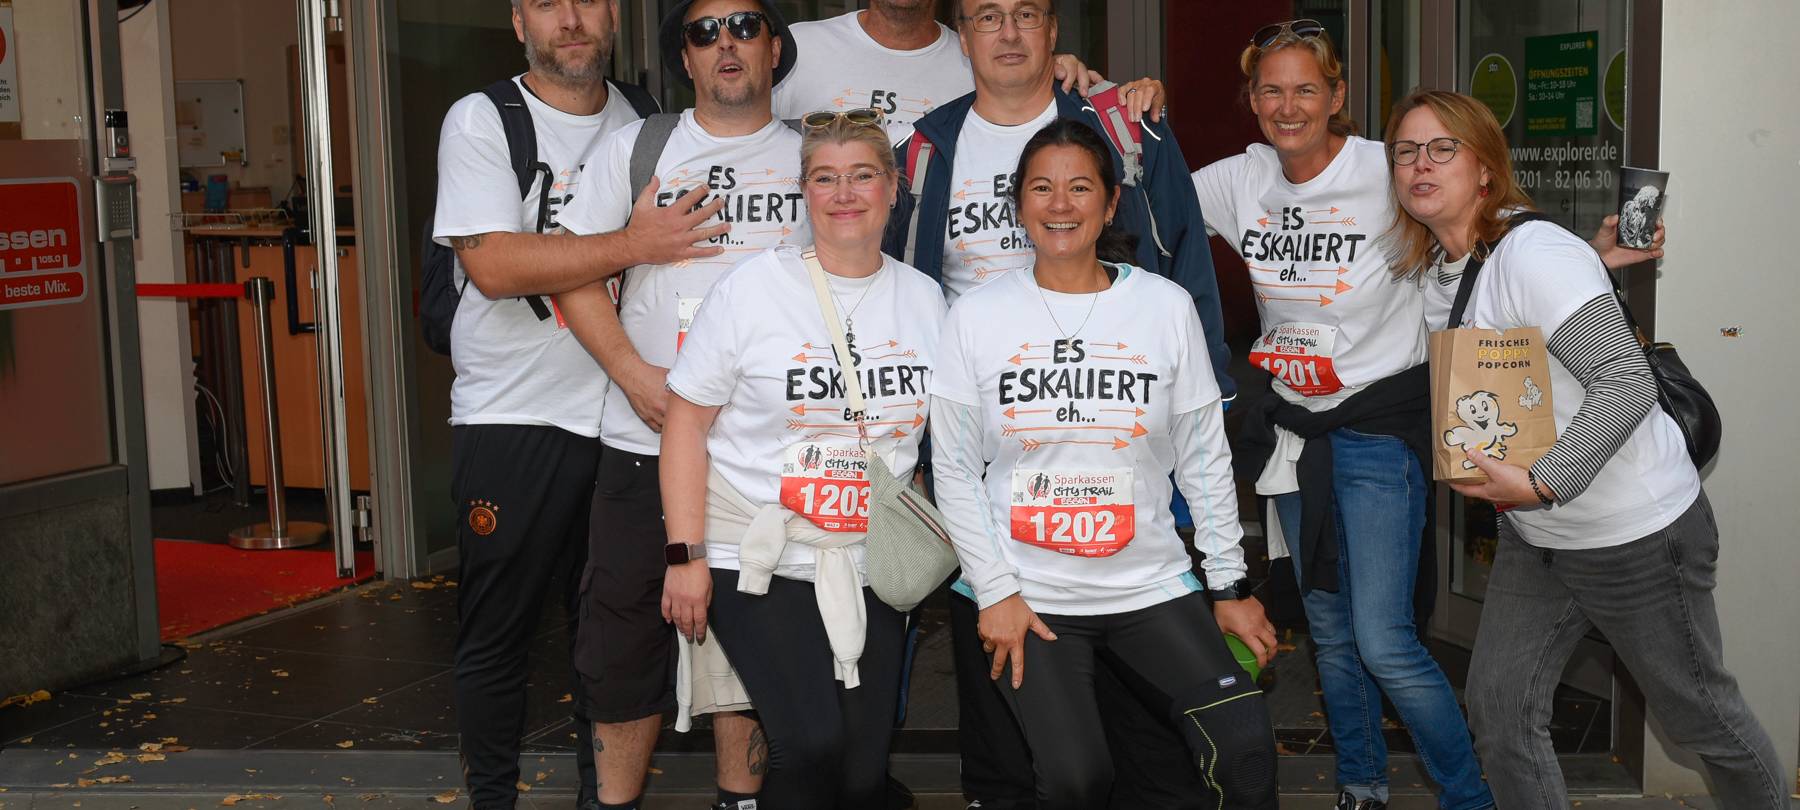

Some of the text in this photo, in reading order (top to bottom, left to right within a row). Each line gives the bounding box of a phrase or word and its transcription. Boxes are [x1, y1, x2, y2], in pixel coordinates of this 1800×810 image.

[1560, 41, 1585, 50] EXPLORER
[870, 89, 897, 114] ES
[1511, 140, 1617, 166] www.explorer.de
[707, 165, 736, 190] ES
[1513, 170, 1540, 188] 0201
[1555, 170, 1570, 188] 82
[1575, 170, 1590, 188] 06
[1595, 170, 1611, 188] 30
[1282, 207, 1304, 230] ES
[1240, 229, 1366, 263] ESKALIERT
[1280, 264, 1306, 281] eh...
[5, 280, 70, 298] beste Mix.
[1279, 325, 1319, 336] Sparkassen
[1053, 339, 1086, 364] ES
[1477, 347, 1530, 360] POPPY
[1478, 338, 1530, 348] FRISCHES
[1477, 360, 1531, 369] POPCORN
[999, 368, 1159, 405] ESKALIERT
[1056, 401, 1096, 423] eh...
[1054, 474, 1115, 485] Sparkassen
[800, 482, 871, 518] 1203
[1030, 510, 1116, 543] 1202
